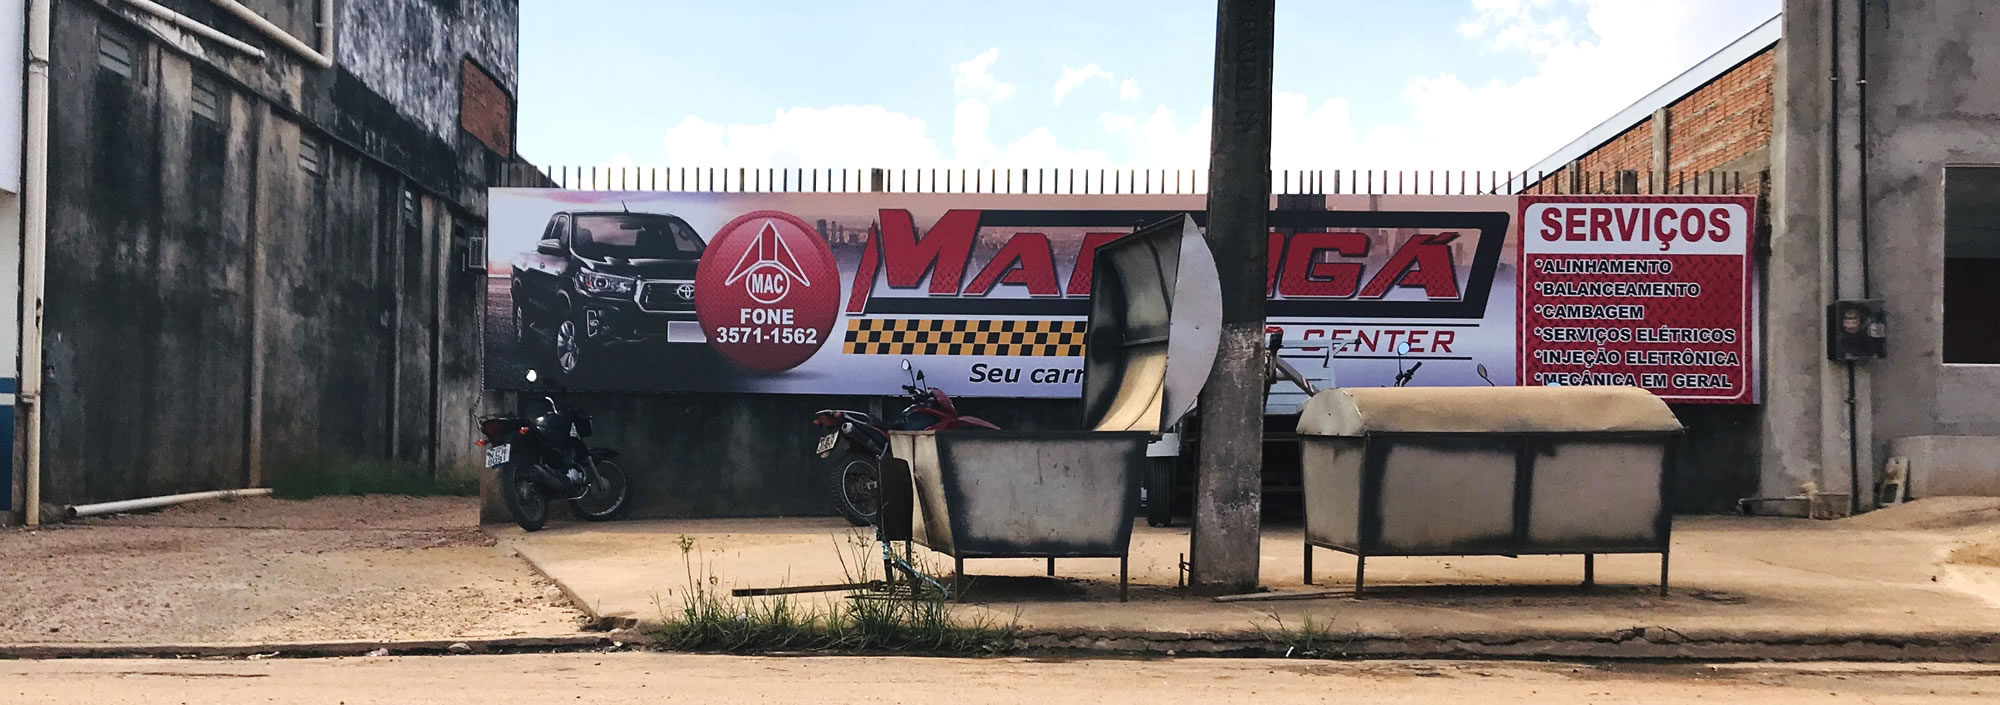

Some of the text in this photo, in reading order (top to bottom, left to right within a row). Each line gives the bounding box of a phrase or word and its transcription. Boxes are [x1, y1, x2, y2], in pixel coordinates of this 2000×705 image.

[1540, 207, 1731, 251] SERVIÇOS
[845, 208, 1461, 315] MAGÁ
[751, 273, 784, 294] MAC
[740, 308, 794, 325] FONE
[716, 327, 817, 344] 3571-1562
[1636, 325, 1736, 343] ELÉTRICOS
[1626, 348, 1739, 366] ELETRÔNICA
[968, 363, 1021, 383] Seu
[1641, 374, 1668, 388] EM
[1672, 374, 1732, 388] GERAL
